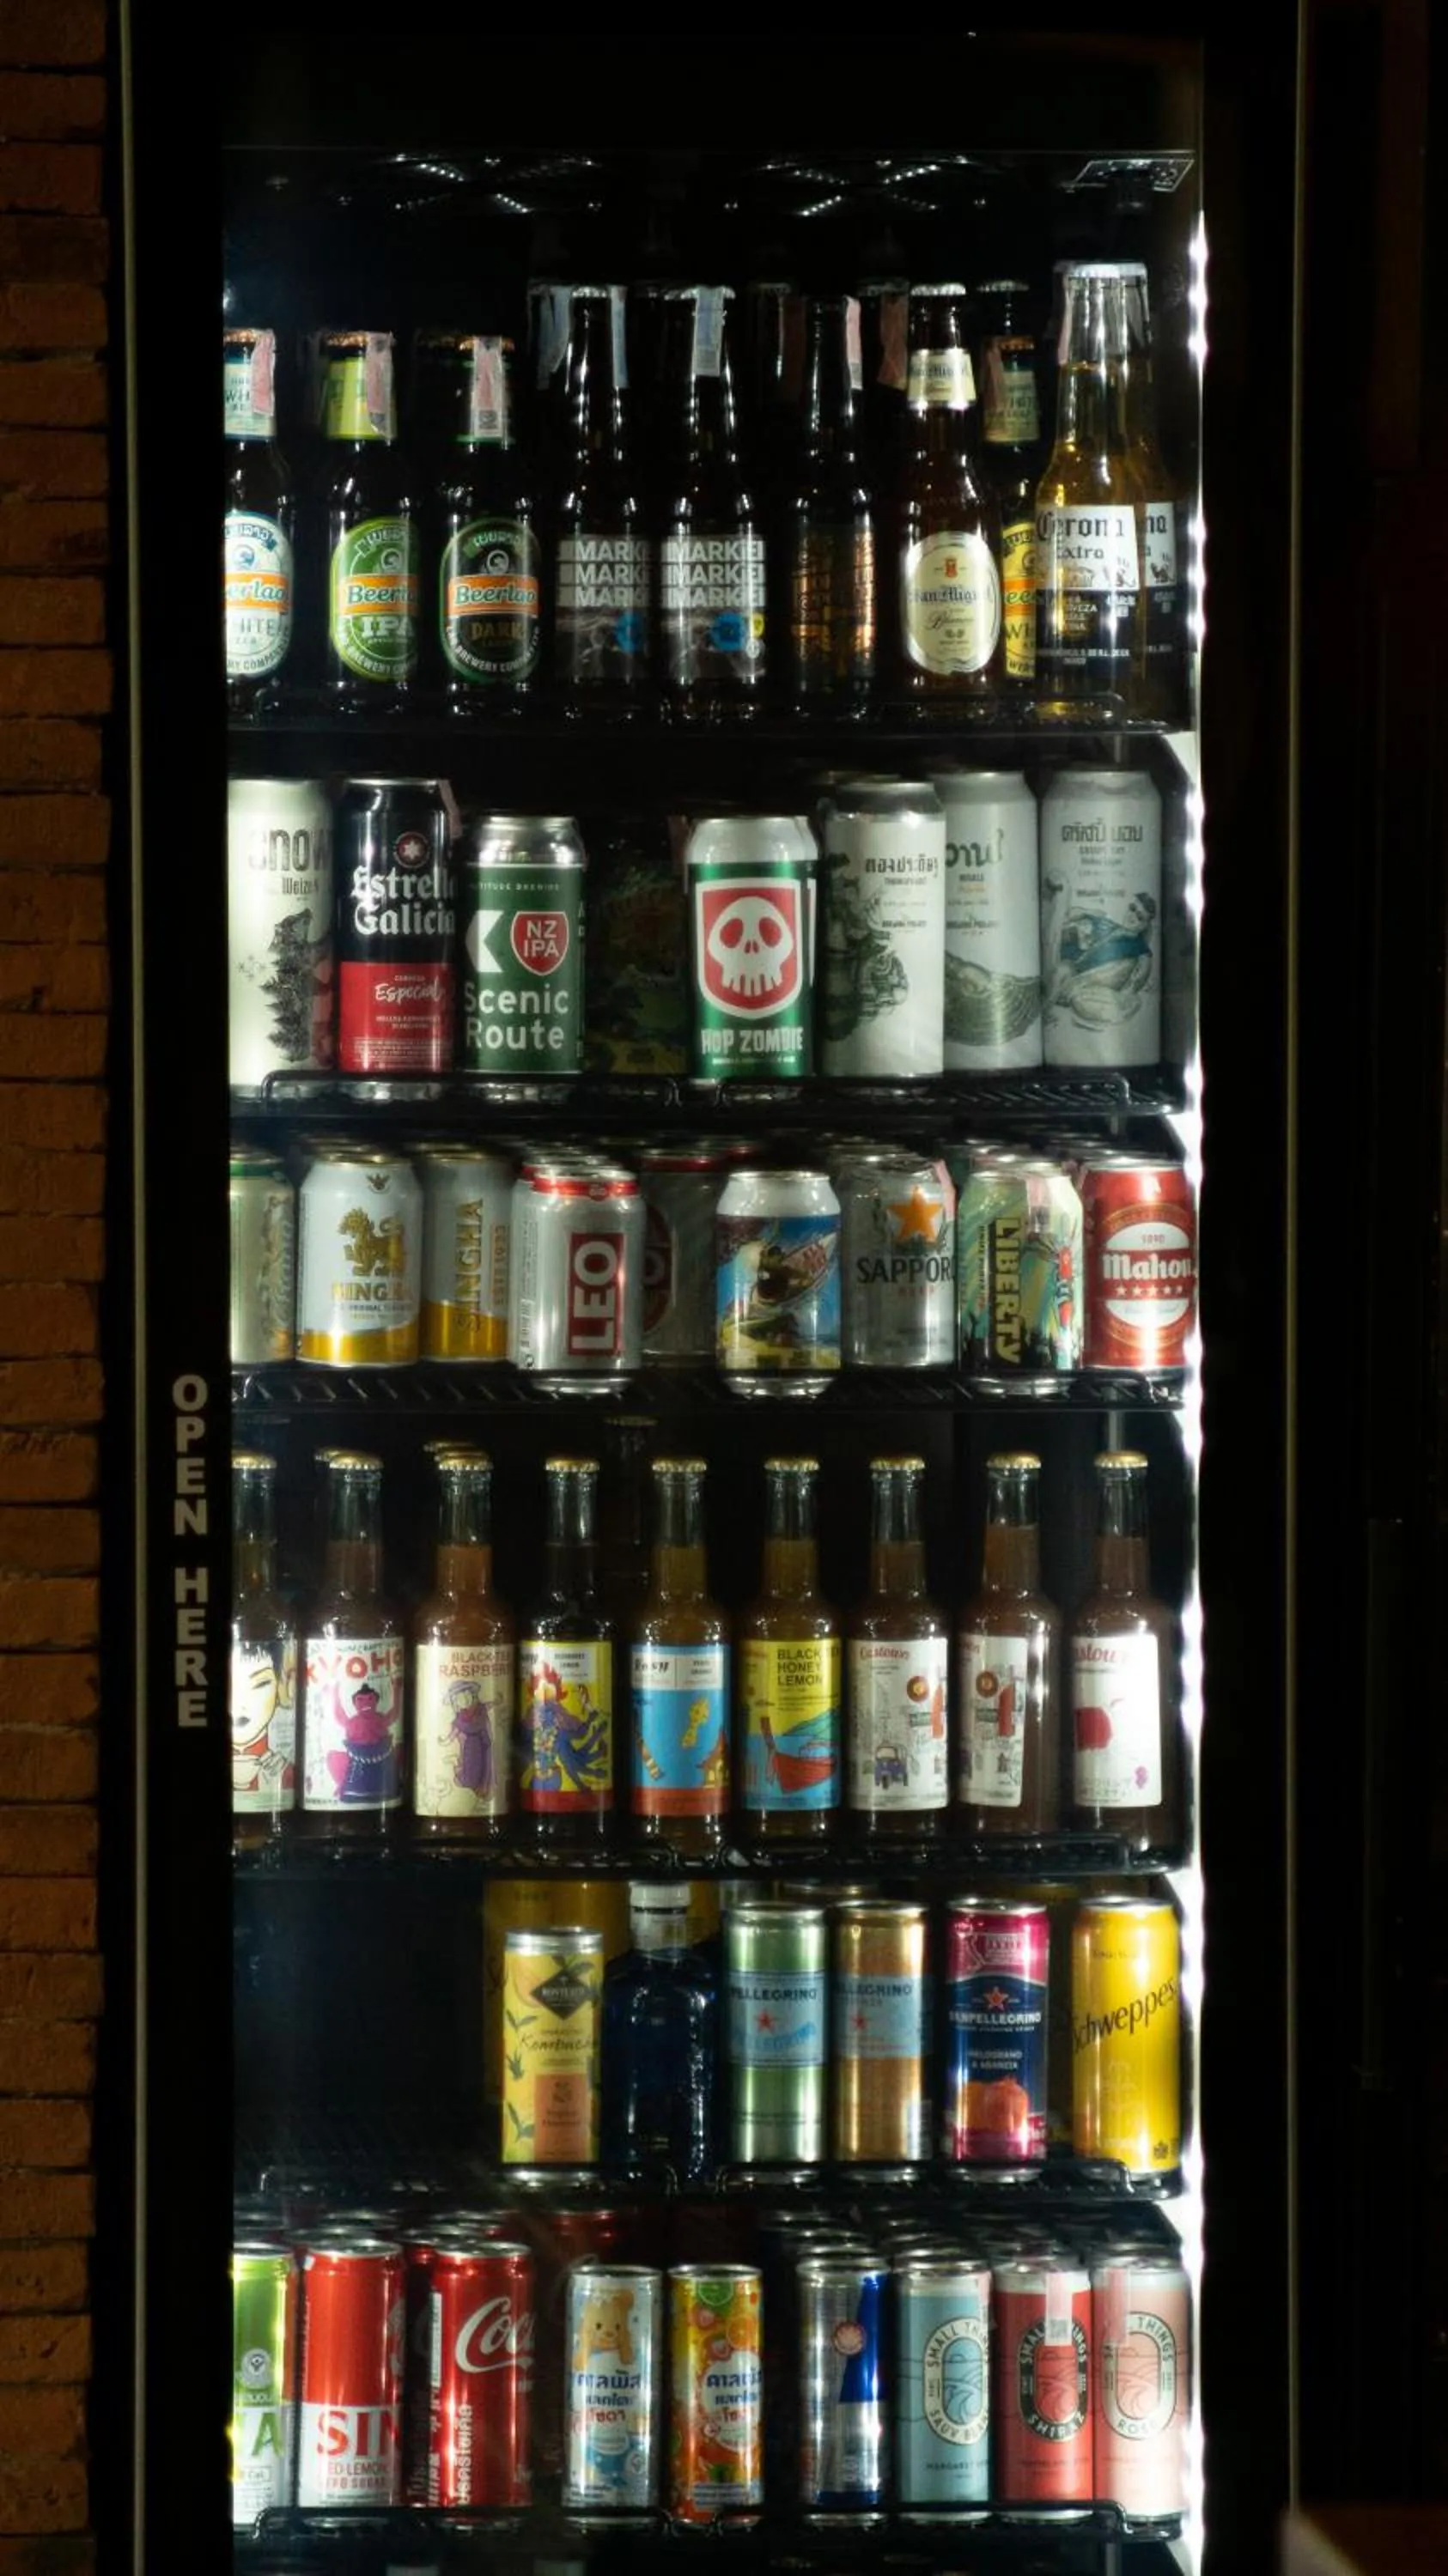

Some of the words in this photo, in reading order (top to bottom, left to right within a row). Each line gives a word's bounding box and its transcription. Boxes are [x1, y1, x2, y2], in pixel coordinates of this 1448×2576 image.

[455, 583, 537, 605] Beerlao
[362, 617, 414, 637] IPA
[472, 621, 526, 640] DARK
[354, 901, 455, 935] Galicia
[526, 920, 558, 939] NZ
[522, 939, 560, 958] IPA
[374, 975, 441, 1005] Especial
[465, 981, 570, 1015] Scenic
[465, 1017, 565, 1049] Route
[700, 1028, 735, 1055] HOP
[739, 1025, 805, 1054] ZOMBIE
[454, 1199, 484, 1333] SINGHA
[570, 1240, 617, 1352] LEO
[995, 1218, 1021, 1364] LIBERTY
[172, 1374, 209, 1536] OPEN
[174, 1567, 209, 1728] HERE
[777, 1648, 822, 1660] BLACK
[777, 1662, 822, 1674] HONEY
[777, 1674, 824, 1686] LEMON
[926, 2324, 959, 2368] SMALL
[1019, 2324, 1045, 2364] SMAL
[1137, 2316, 1174, 2363] THINGS
[1118, 2419, 1157, 2434] ROS
